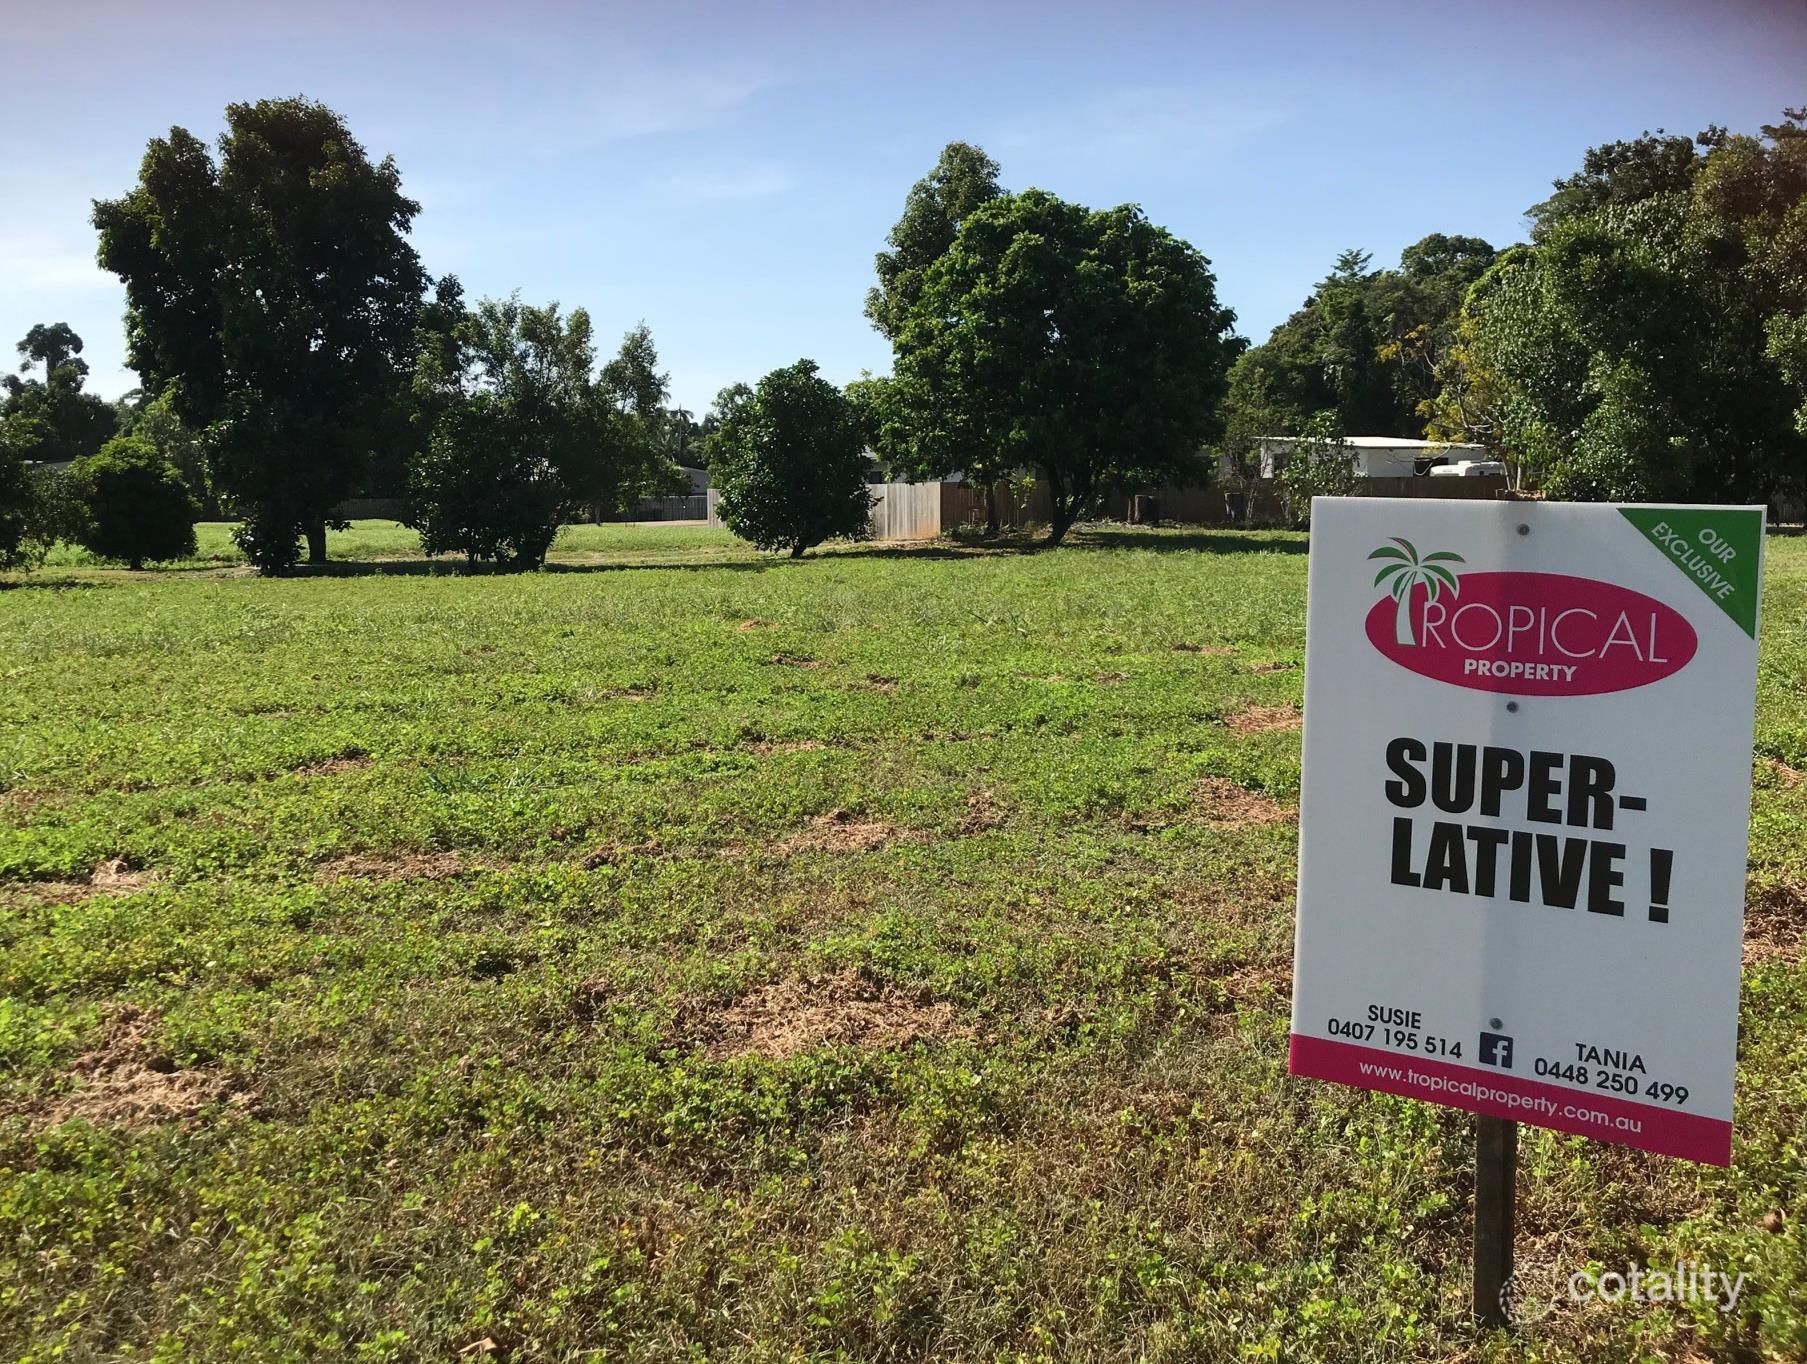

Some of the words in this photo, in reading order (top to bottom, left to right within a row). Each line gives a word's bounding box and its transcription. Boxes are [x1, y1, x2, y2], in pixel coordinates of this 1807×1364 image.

[1651, 521, 1735, 600] EXCLUSIVE
[1698, 528, 1736, 564] OUR
[1464, 658, 1577, 682] PROPERTY
[1385, 737, 1647, 831] SUPER-
[1367, 1004, 1422, 1030] SUSIE
[1327, 1018, 1374, 1042] 0407
[1383, 1028, 1418, 1050] 195
[1424, 1037, 1462, 1059] 514
[1575, 1043, 1646, 1074] TANIA
[1359, 1061, 1642, 1133] www.tropicalproperty.com.au
[1534, 1057, 1589, 1085] 0448
[1596, 1070, 1638, 1095] 250
[1645, 1081, 1689, 1105] 499
